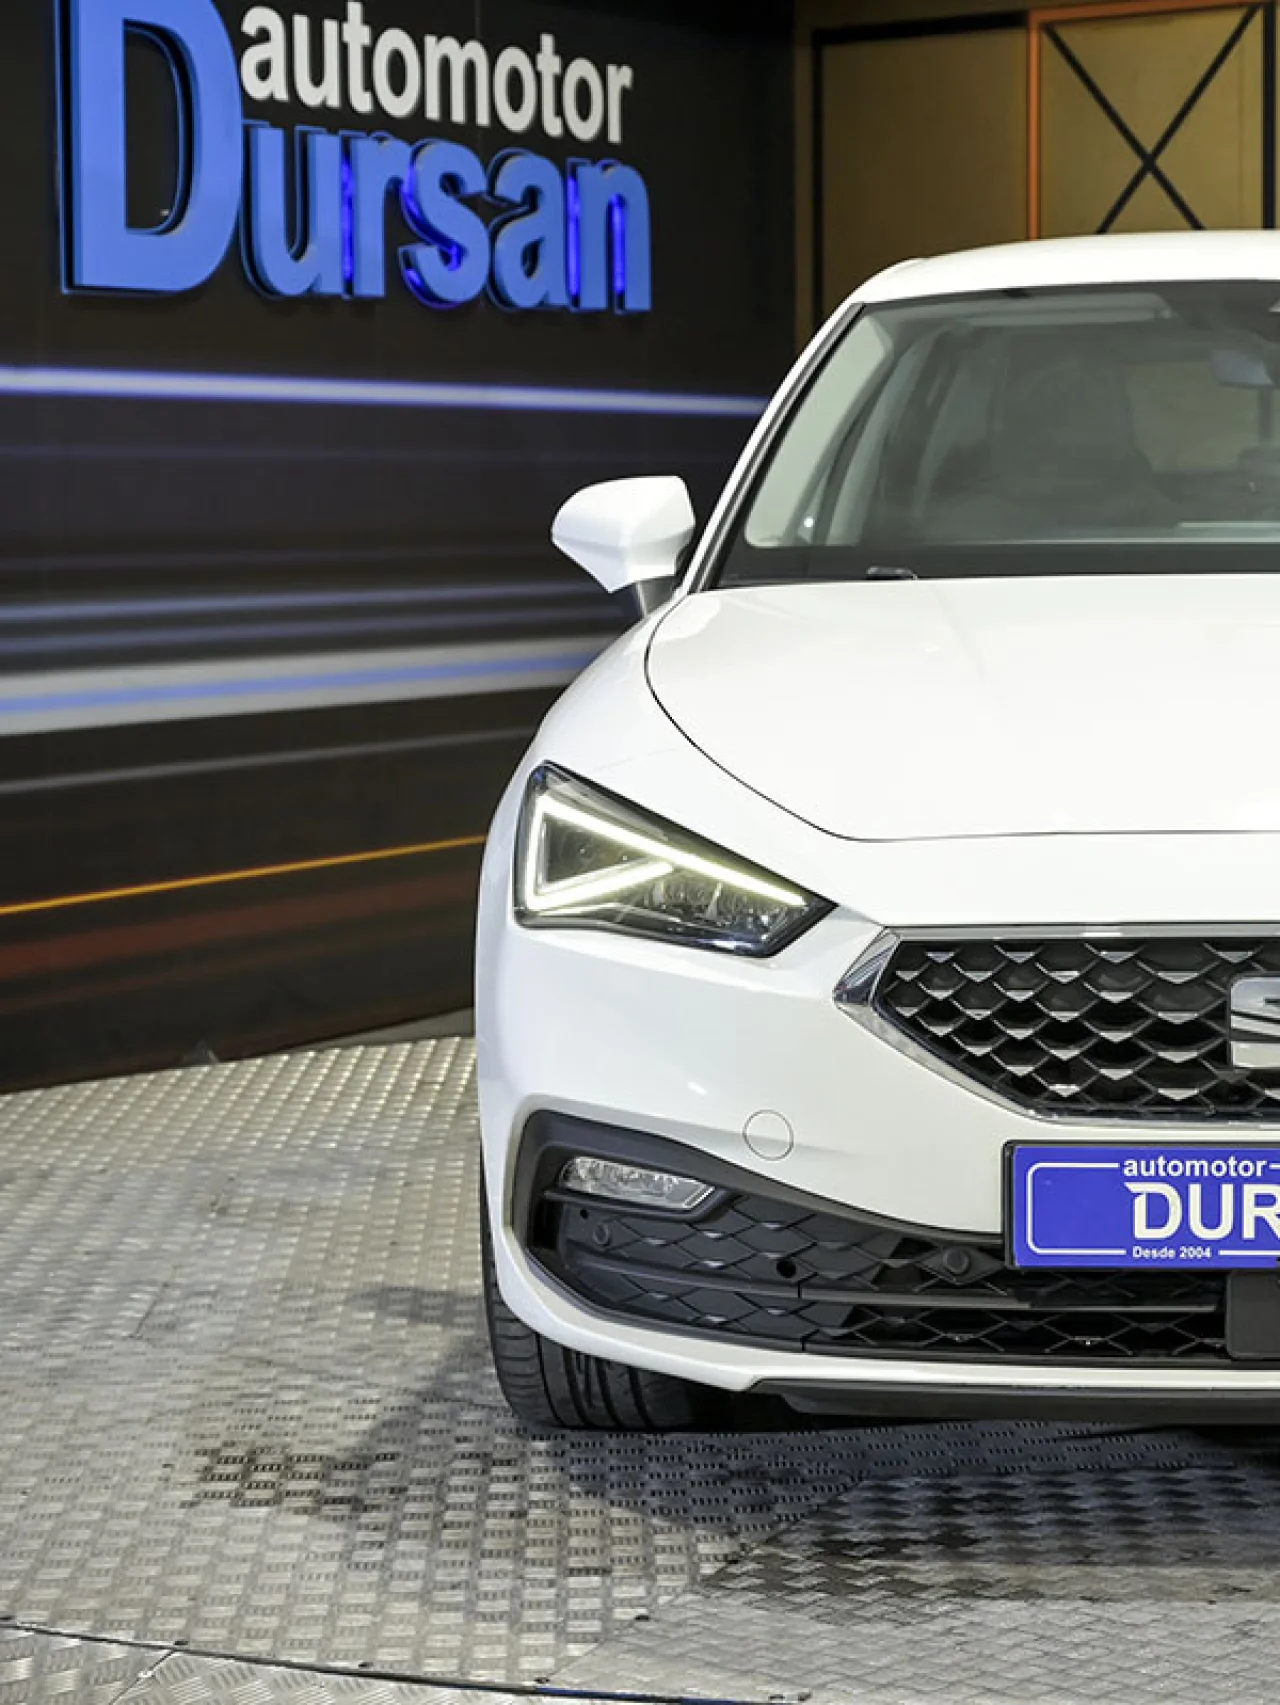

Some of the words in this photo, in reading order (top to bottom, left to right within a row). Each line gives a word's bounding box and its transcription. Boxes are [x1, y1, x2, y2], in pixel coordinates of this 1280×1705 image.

[240, 1, 633, 143] automotor
[62, 0, 652, 312] Dursan
[1123, 1155, 1268, 1178] automotor
[1132, 1245, 1176, 1261] Desde
[1179, 1245, 1213, 1261] 2004
